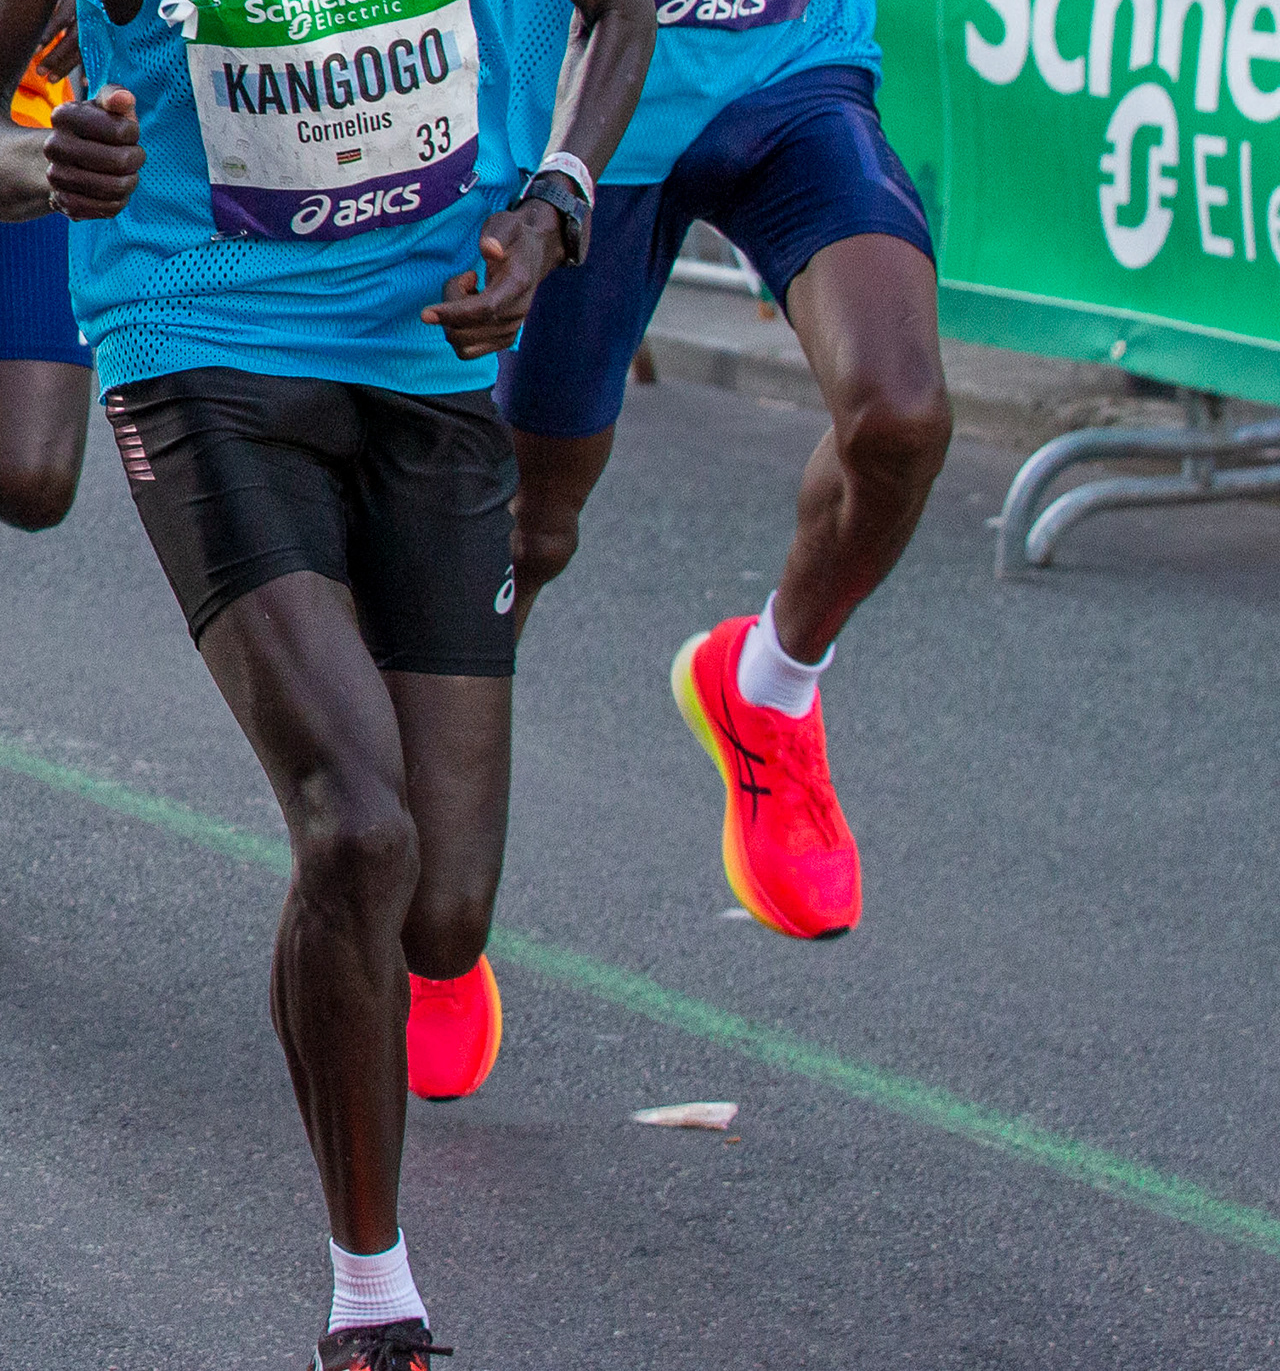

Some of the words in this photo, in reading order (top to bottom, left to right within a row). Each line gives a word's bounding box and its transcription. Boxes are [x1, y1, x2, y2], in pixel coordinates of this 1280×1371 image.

[315, 0, 402, 31] Electric
[222, 27, 449, 116] KANGOGO
[297, 110, 393, 144] Cornelius
[416, 116, 451, 162] 33
[334, 182, 421, 227] asics
